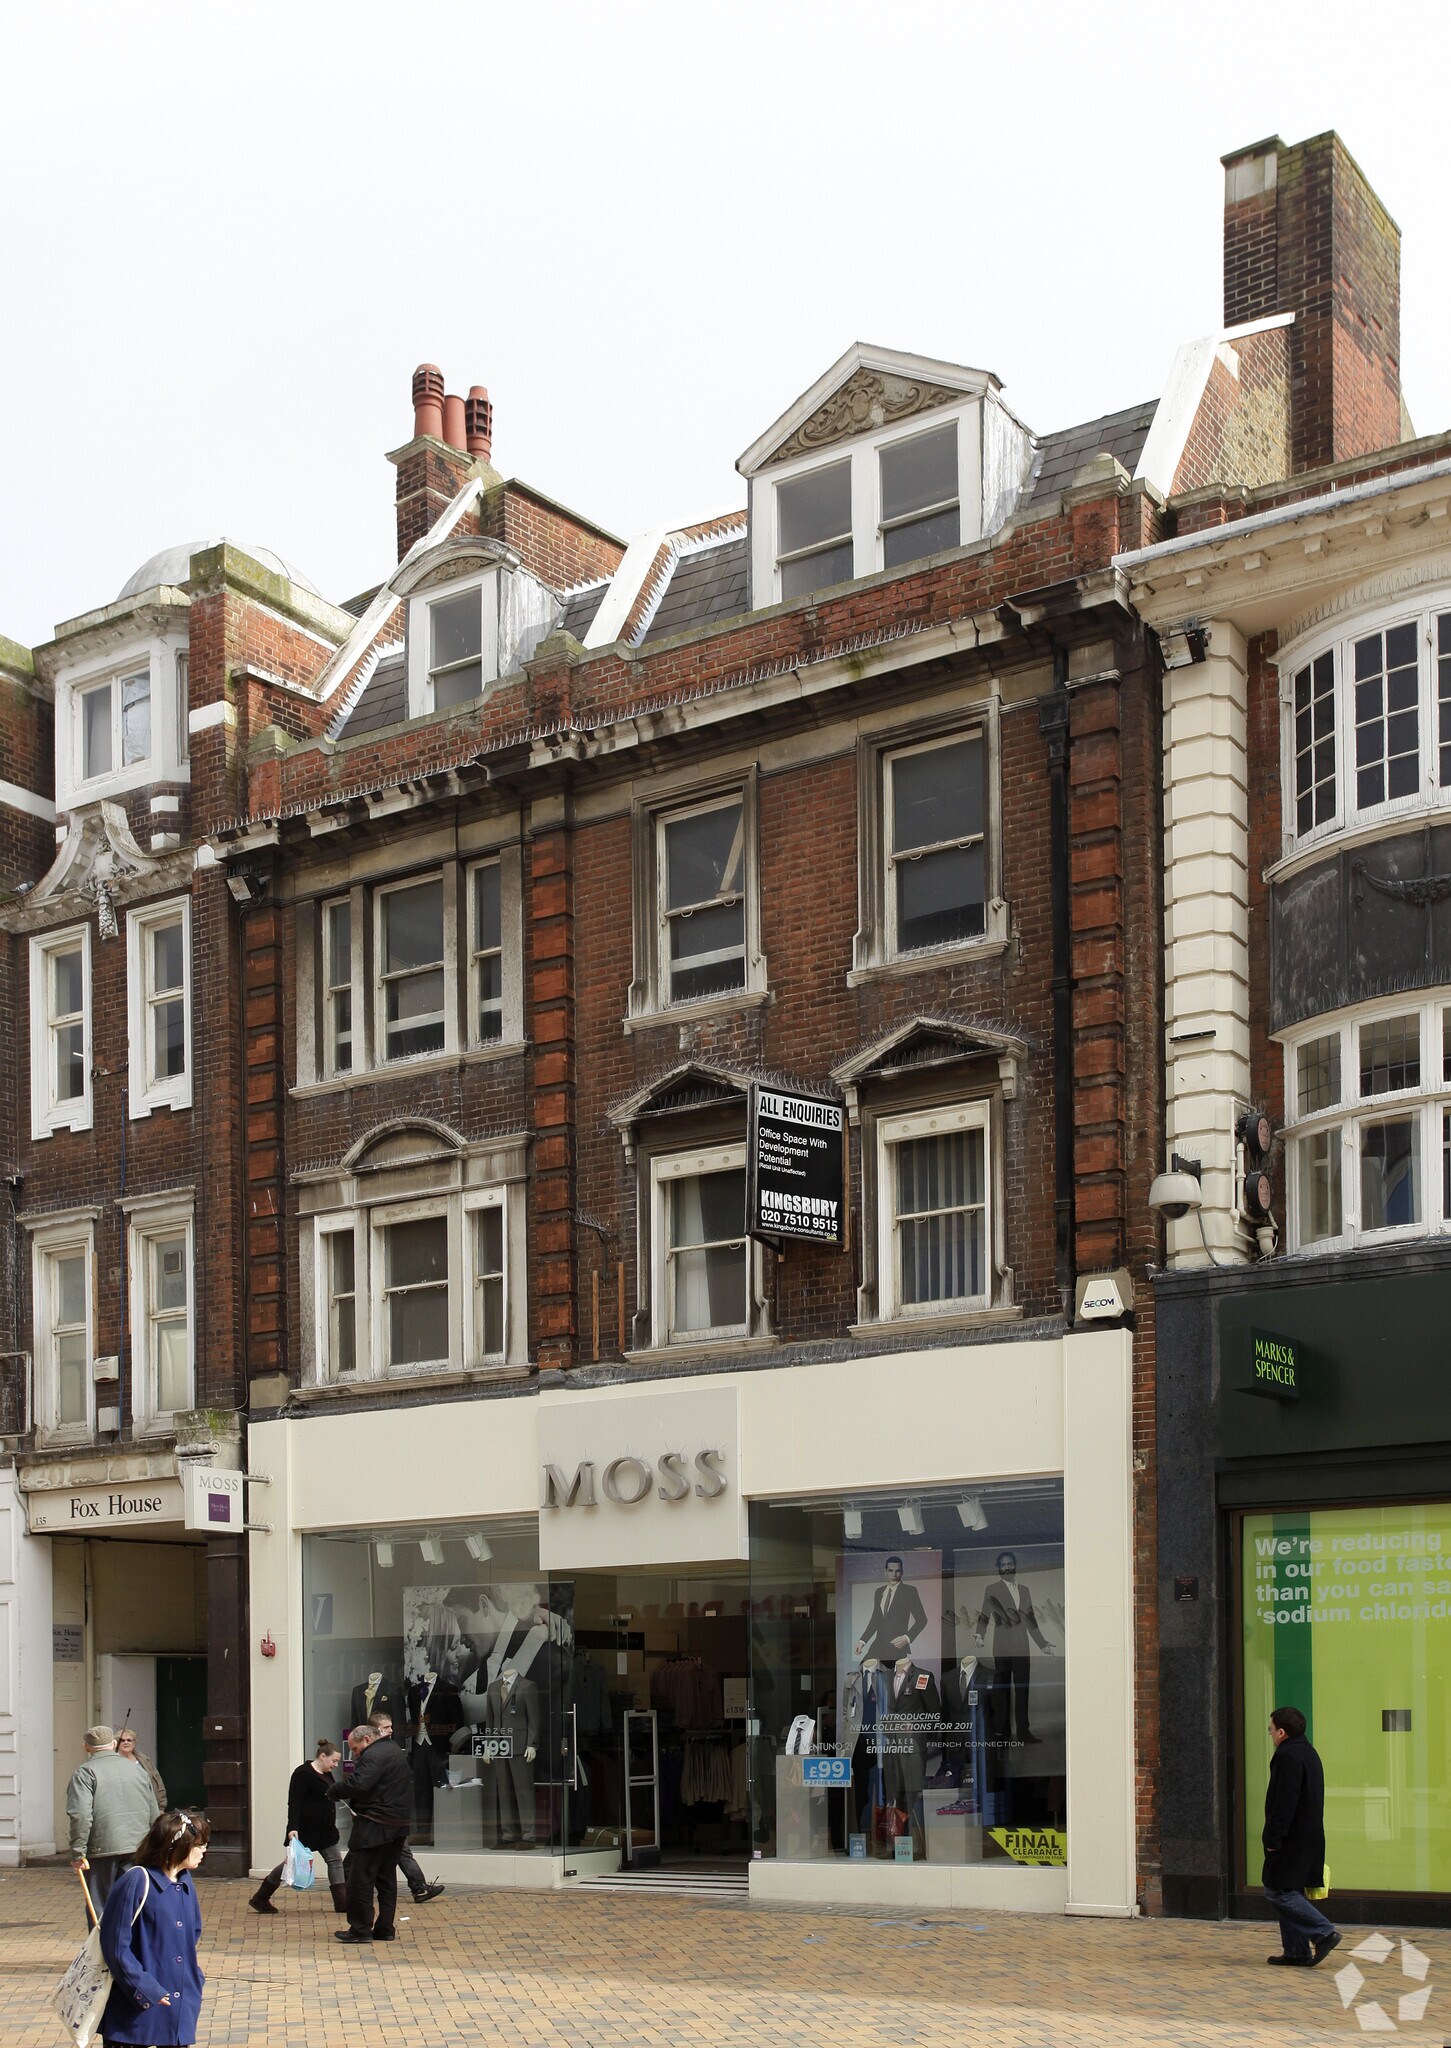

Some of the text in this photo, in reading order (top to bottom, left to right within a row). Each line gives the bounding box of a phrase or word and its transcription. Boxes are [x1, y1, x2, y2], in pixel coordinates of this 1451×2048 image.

[760, 1096, 840, 1127] ALL ENQUIRIES
[759, 1127, 828, 1149] Office Space With
[759, 1139, 809, 1157] Development
[759, 1151, 791, 1166] Potential
[761, 1189, 838, 1218] KINGSBURY
[761, 1209, 838, 1231] 020 7510 9515
[761, 1222, 837, 1237] www.kingsbury-consultants.co.uk
[1084, 1298, 1115, 1309] SECOM
[1255, 1359, 1296, 1386] SPENCER
[199, 1475, 239, 1492] MOSS
[540, 1449, 728, 1509] MOSS
[70, 1494, 162, 1519] Fox House
[34, 1517, 47, 1526] 135
[1331, 1531, 1442, 1551] reducing
[1256, 1561, 1277, 1579] in
[1285, 1562, 1325, 1578] our
[1333, 1556, 1387, 1575] food
[1256, 1585, 1309, 1602] than
[1317, 1583, 1360, 1603] you
[1368, 1581, 1413, 1597] can
[725, 1706, 745, 1714] £139
[880, 1712, 941, 1721] INTRODUCING
[850, 1722, 973, 1732] NEW COLLECTIONS FOR 2011
[475, 1740, 510, 1756] £199
[802, 1742, 853, 1751] VENTUNO 21
[809, 1760, 845, 1778] £99
[1005, 1834, 1060, 1849] FINAL
[1012, 1848, 1063, 1856] CLEARANCE
